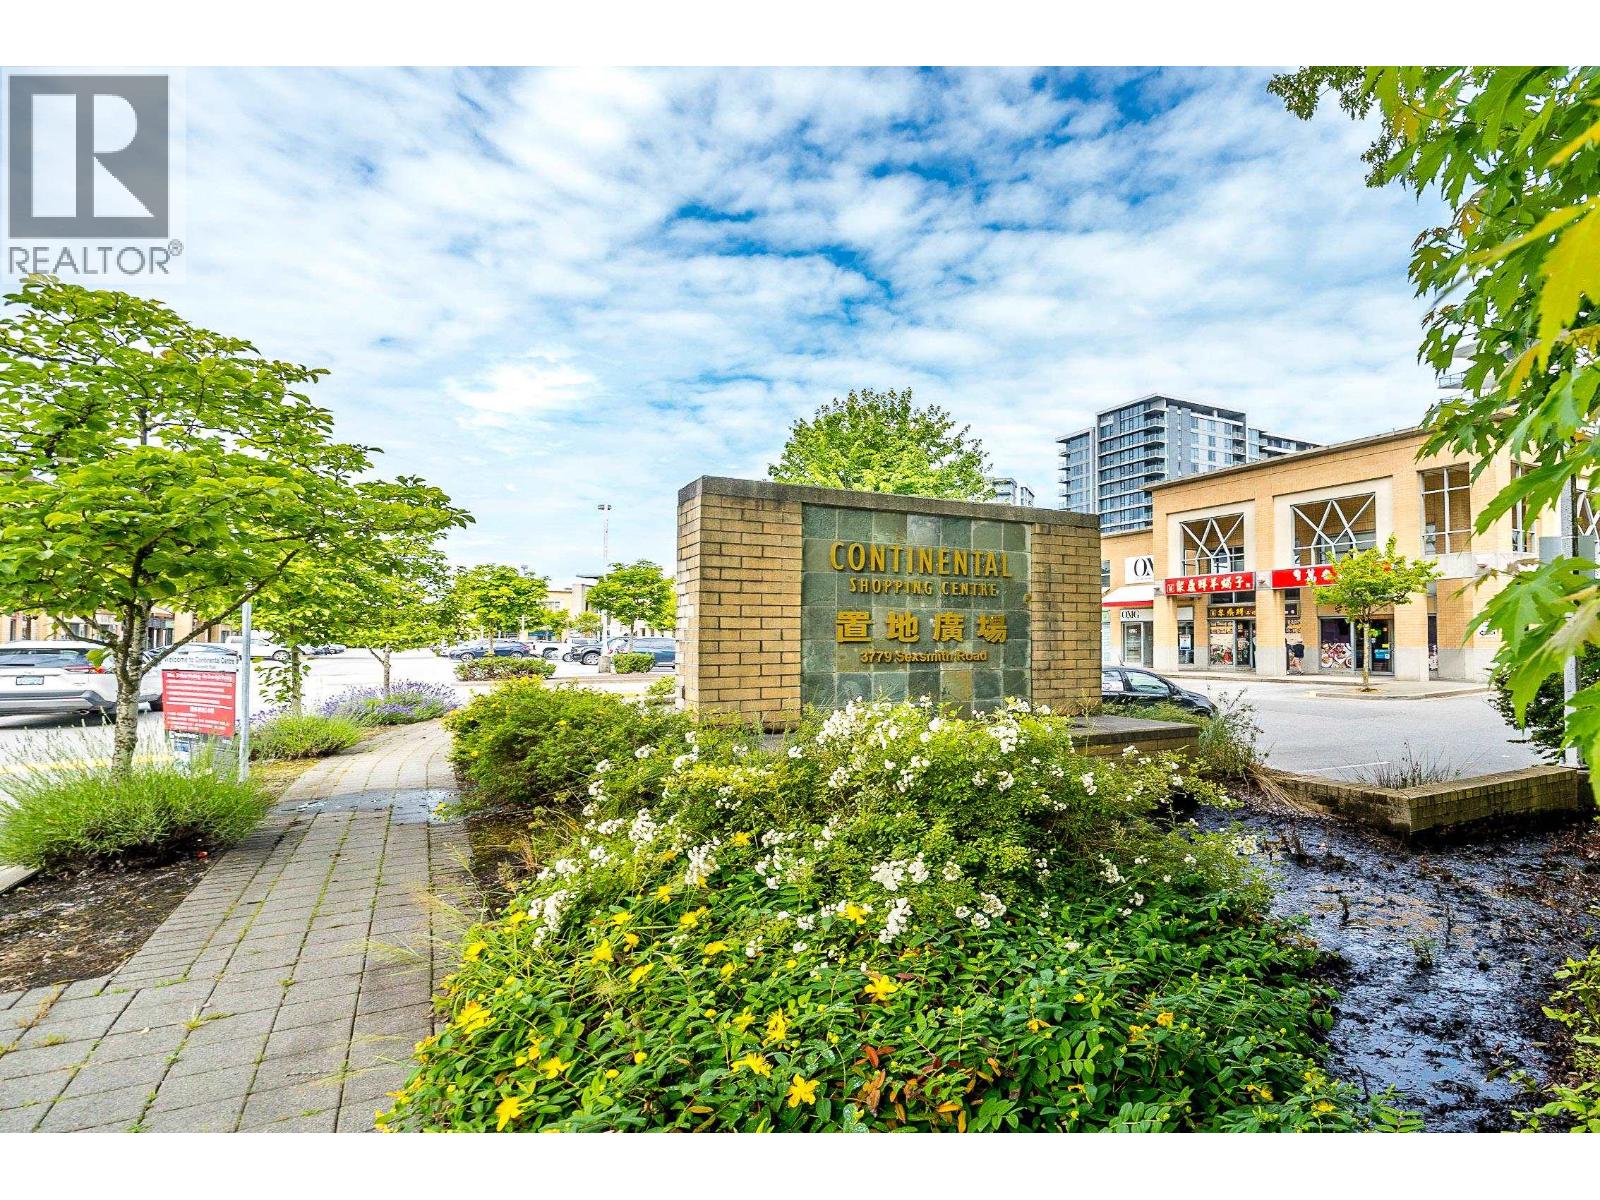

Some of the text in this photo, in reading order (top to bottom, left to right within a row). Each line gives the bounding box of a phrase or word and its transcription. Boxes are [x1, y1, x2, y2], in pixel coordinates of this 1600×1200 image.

[830, 541, 1012, 579] CONTINENTAL
[849, 576, 998, 597] SHOPPING CENTRE
[1121, 610, 1140, 619] OMG
[835, 610, 1009, 645] 置地廣場
[859, 649, 988, 664] 3779 Sexsmith Road
